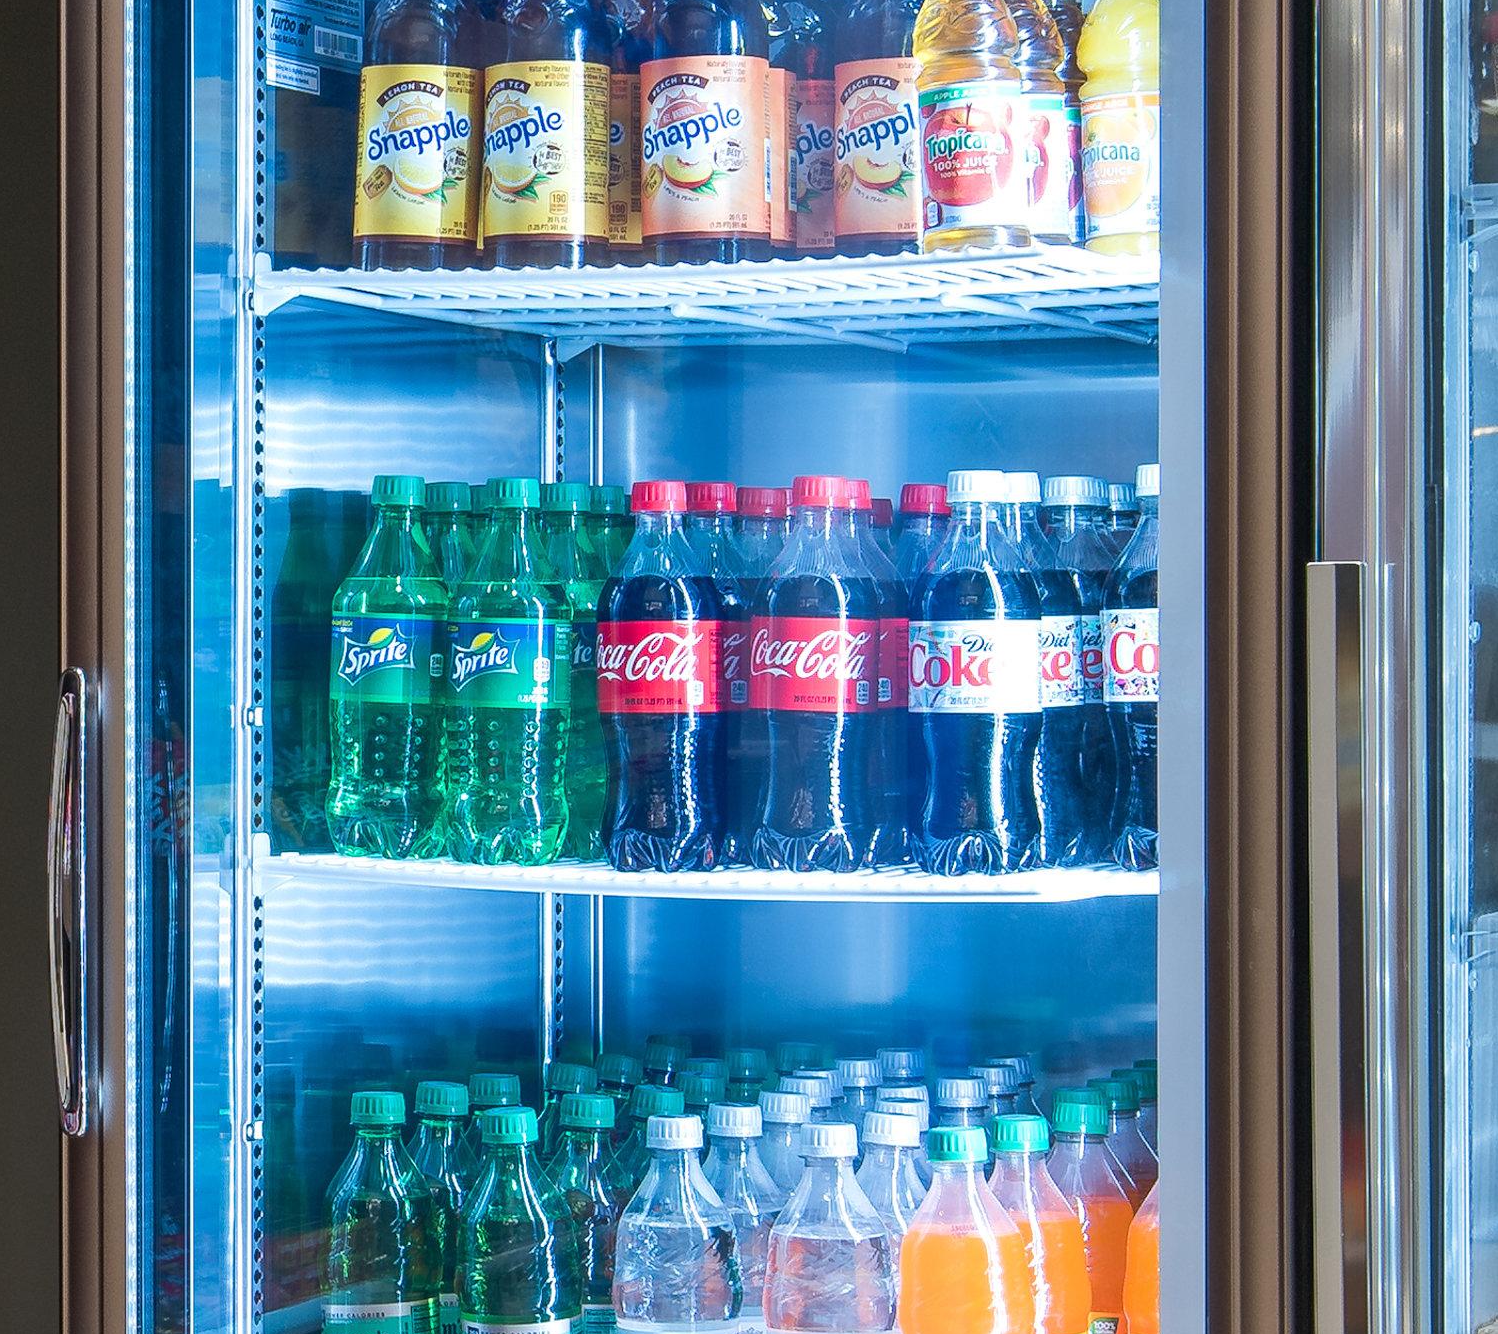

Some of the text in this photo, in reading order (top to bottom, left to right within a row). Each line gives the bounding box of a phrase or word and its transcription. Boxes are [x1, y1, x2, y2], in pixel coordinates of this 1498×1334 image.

[382, 82, 444, 105] LEMON TEA
[651, 75, 702, 101] PEACH TEA
[367, 110, 471, 162] Snapple
[485, 107, 563, 155] napple
[643, 103, 742, 160] Snapple
[347, 642, 408, 675] Sprite
[453, 647, 510, 681] Sprite
[750, 628, 871, 681] Coca-Cola
